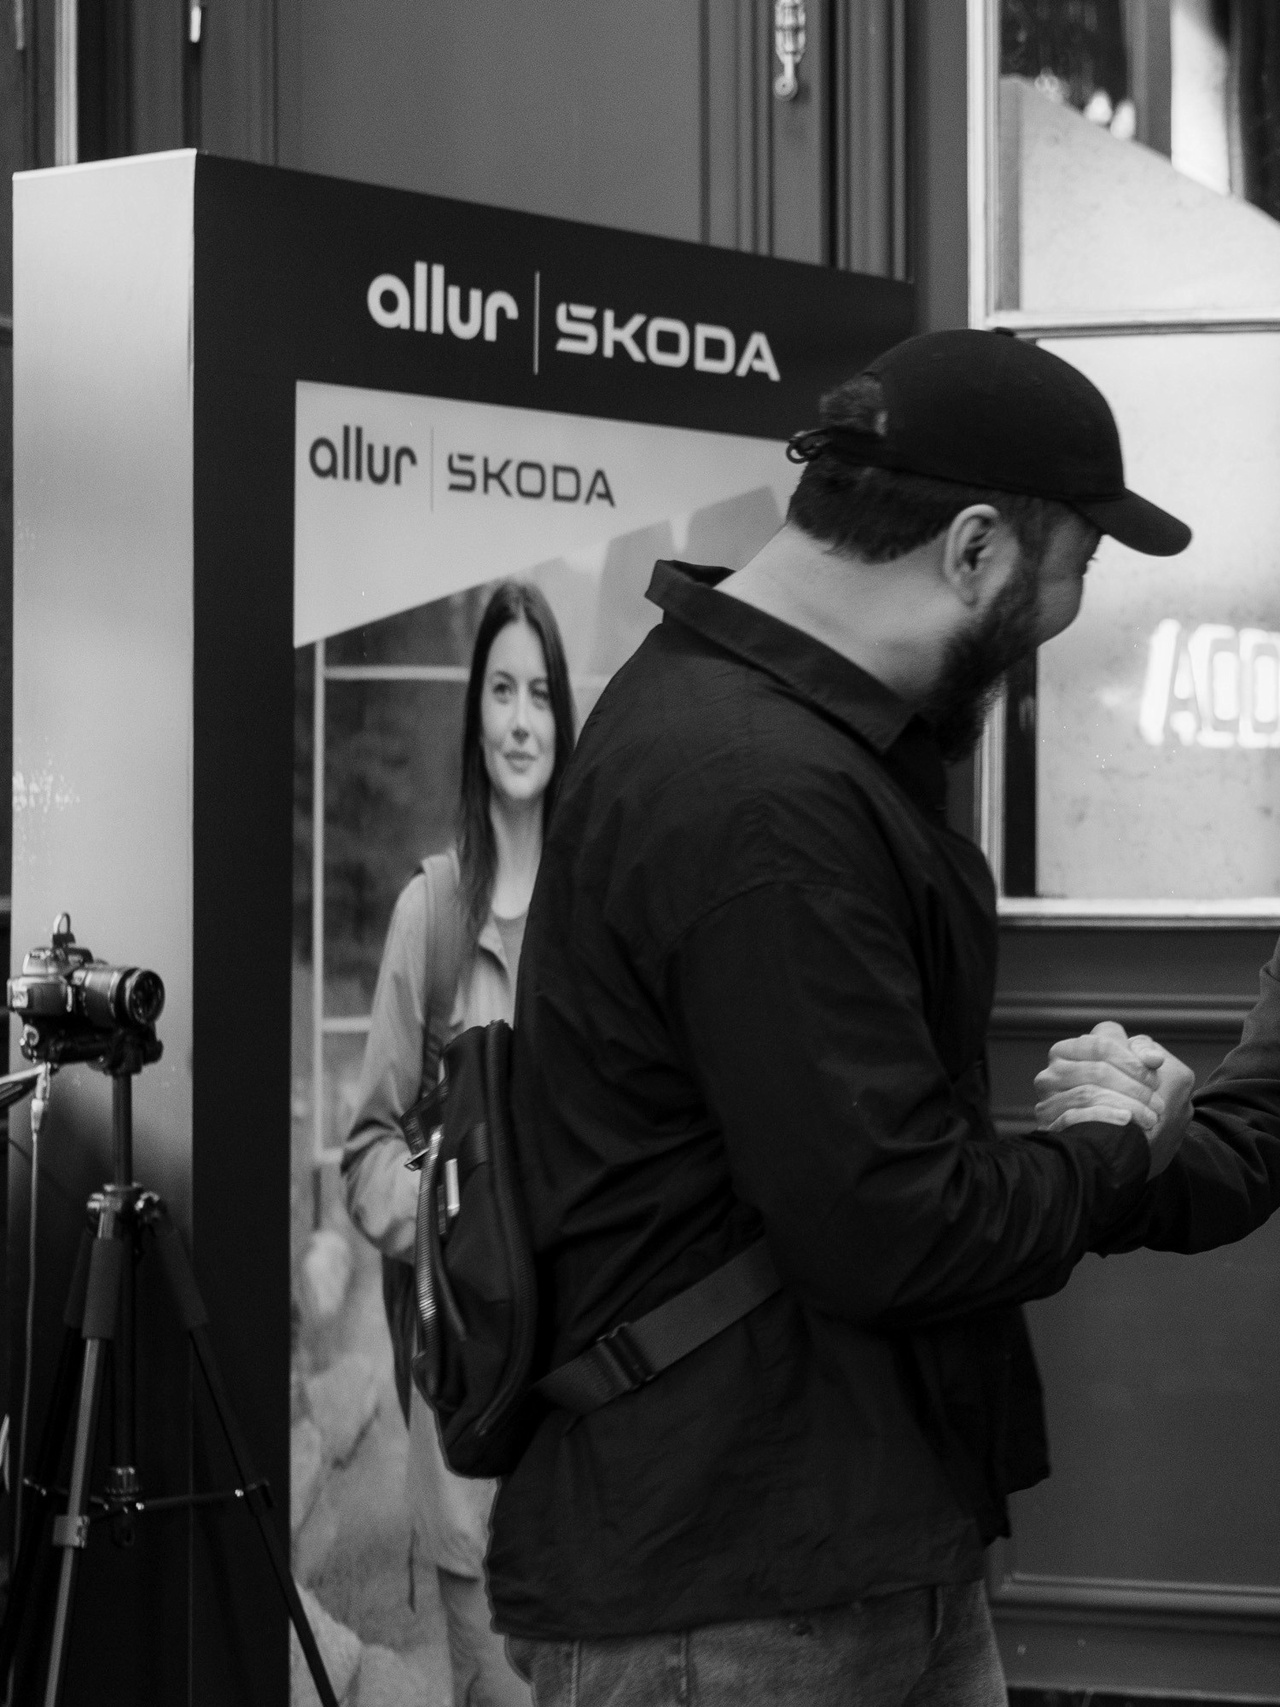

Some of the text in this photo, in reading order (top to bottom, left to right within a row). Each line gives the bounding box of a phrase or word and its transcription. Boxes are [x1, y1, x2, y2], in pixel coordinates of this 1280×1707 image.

[366, 260, 781, 382] allur SKODA
[308, 424, 616, 508] allur SKODA
